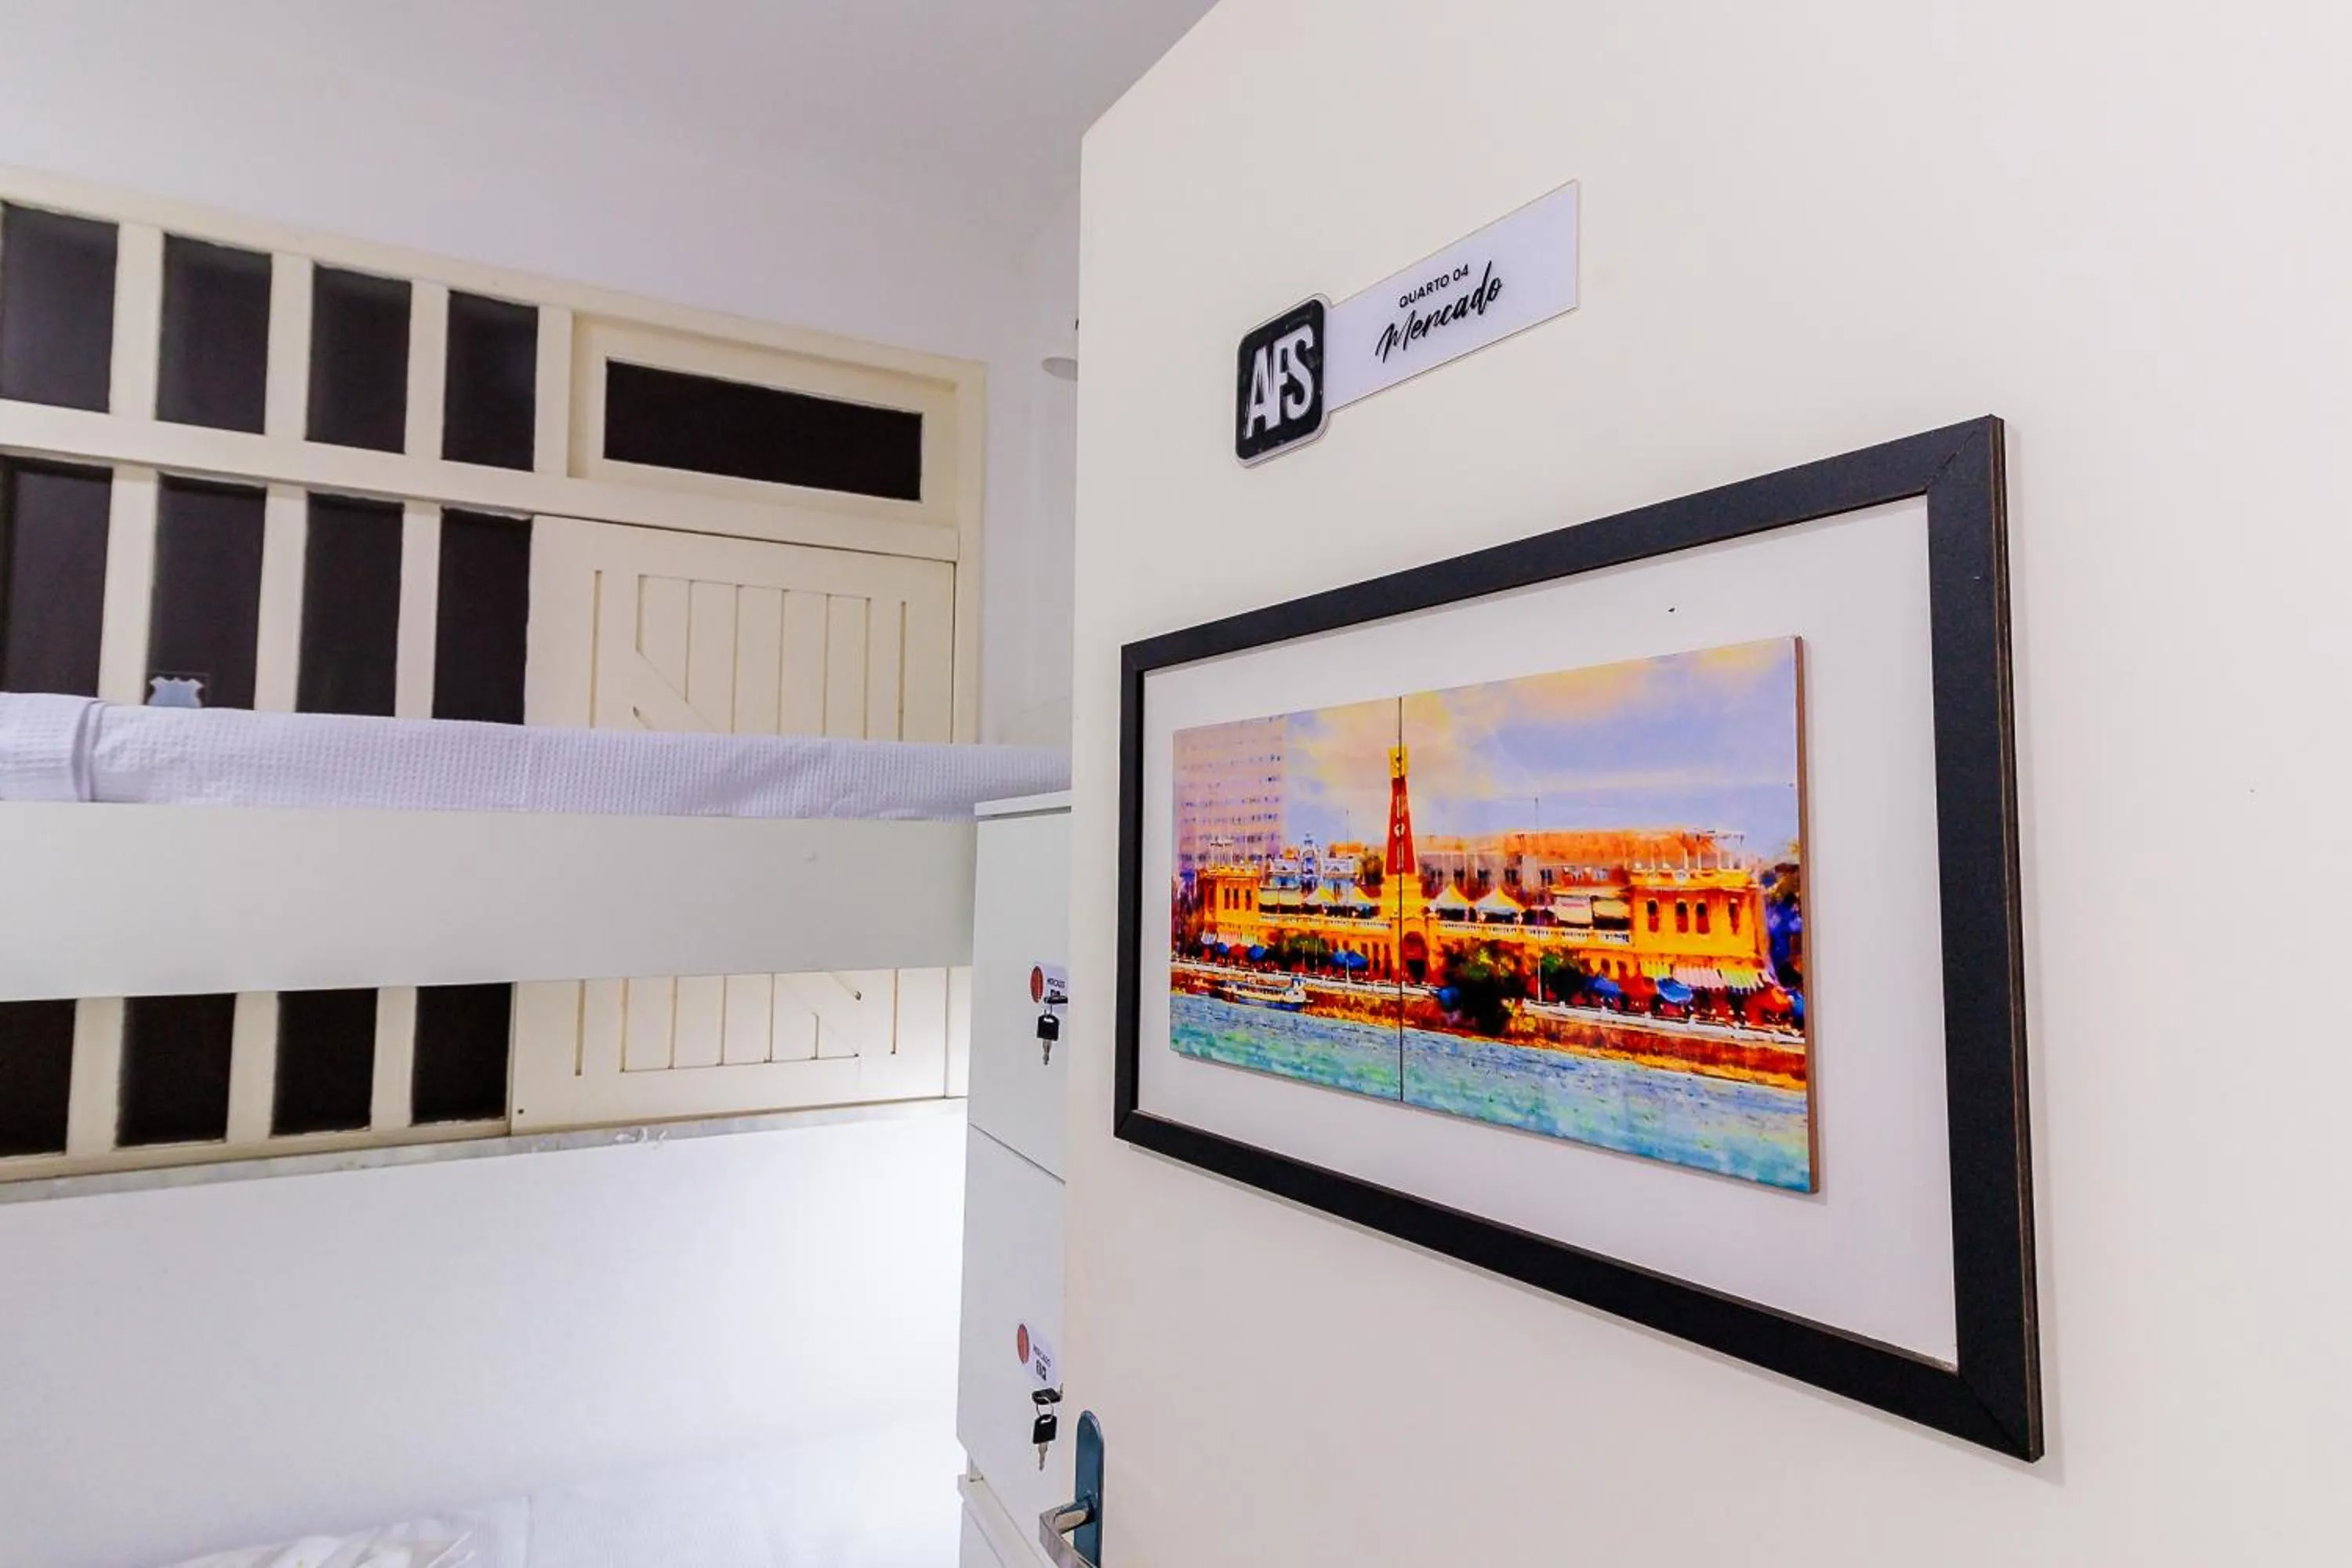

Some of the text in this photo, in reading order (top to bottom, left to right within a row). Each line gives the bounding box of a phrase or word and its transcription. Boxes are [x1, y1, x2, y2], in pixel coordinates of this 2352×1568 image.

[1375, 260, 1503, 363] Mercado
[1399, 263, 1469, 308] QUARTO 04
[1243, 324, 1314, 439] AFS
